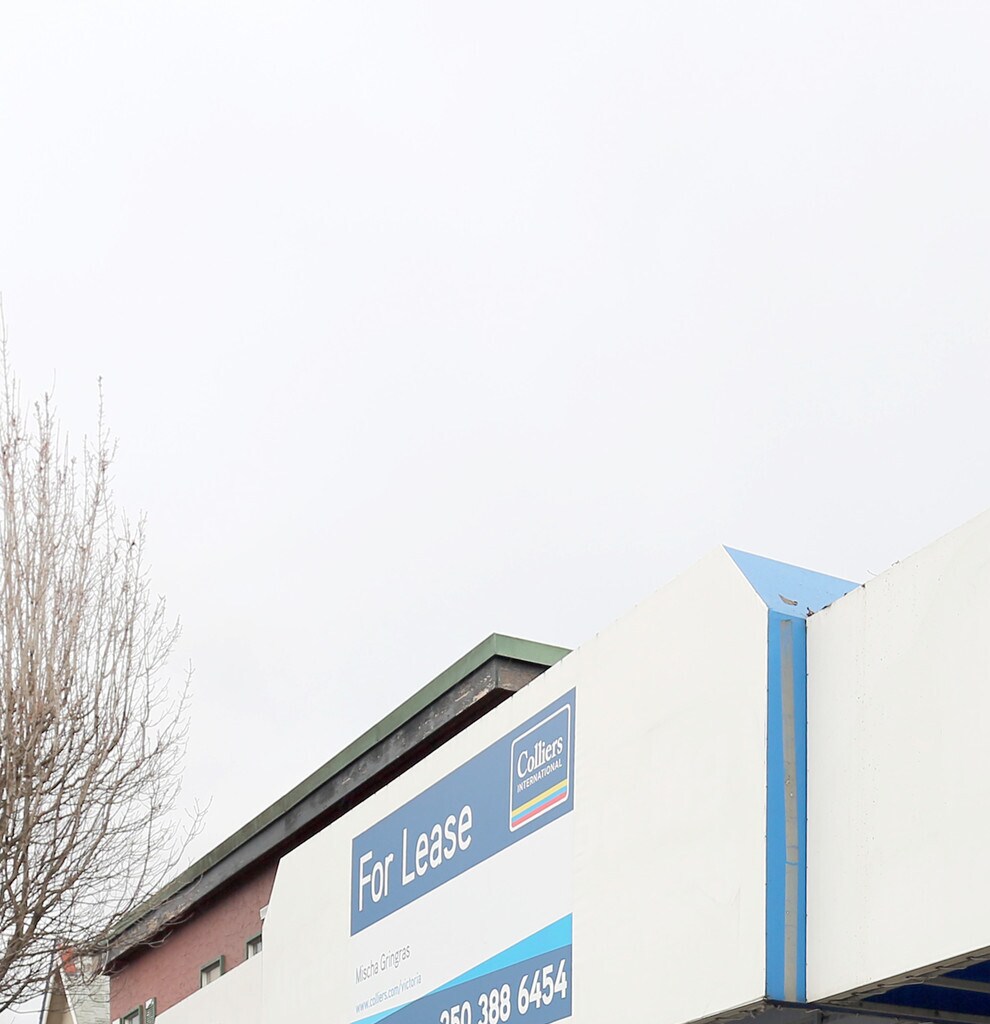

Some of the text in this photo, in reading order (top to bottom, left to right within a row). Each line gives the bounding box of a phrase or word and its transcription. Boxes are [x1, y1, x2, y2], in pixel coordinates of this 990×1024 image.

[516, 758, 563, 794] INTERNATIONAL
[517, 736, 563, 778] Colliers
[358, 805, 473, 912] For Lease
[356, 945, 411, 985] Mischa Gringras
[355, 972, 422, 1013] www.colliers.com/victoria
[517, 959, 567, 1015] 6454
